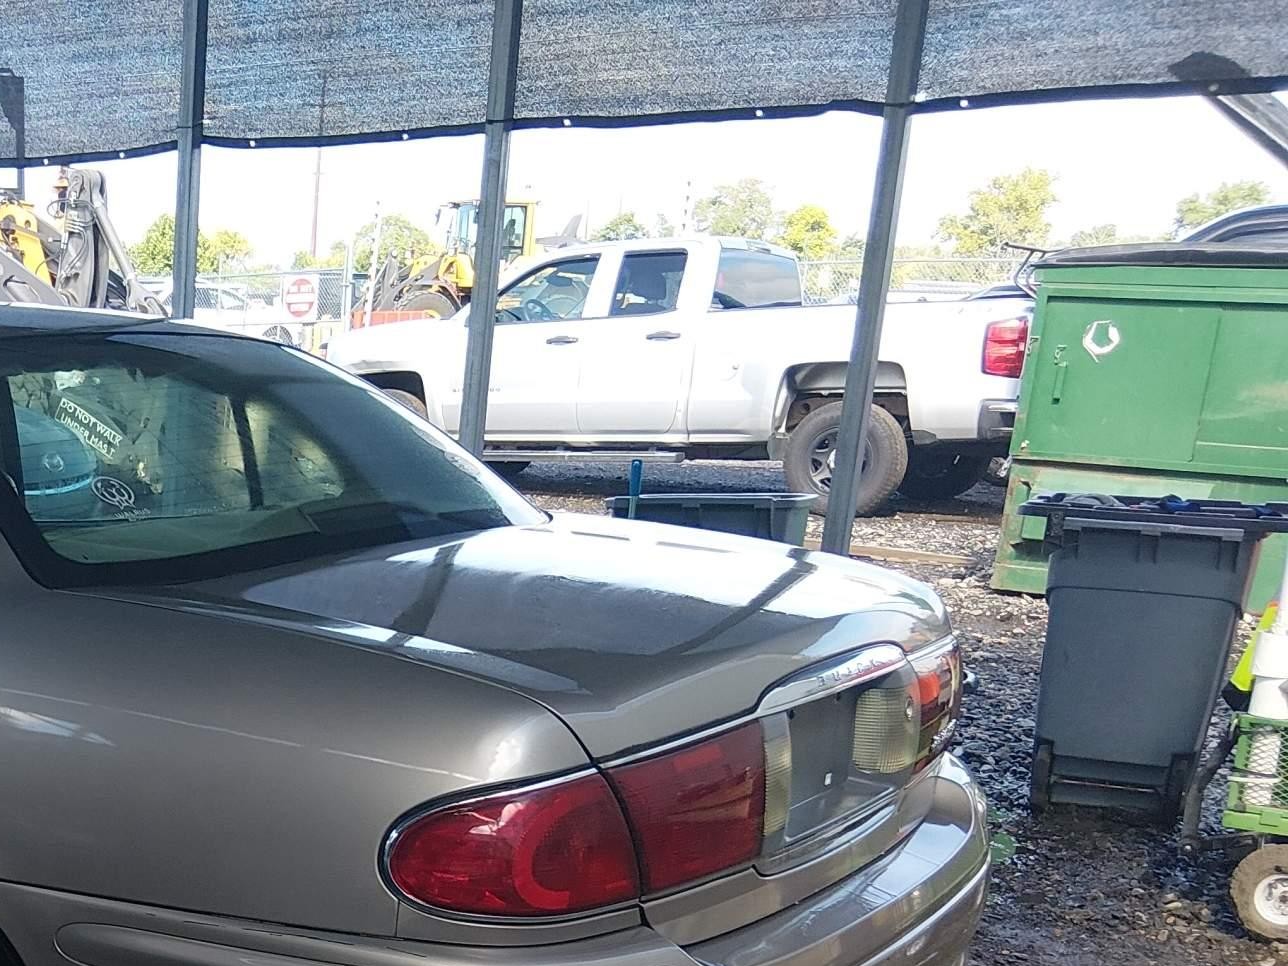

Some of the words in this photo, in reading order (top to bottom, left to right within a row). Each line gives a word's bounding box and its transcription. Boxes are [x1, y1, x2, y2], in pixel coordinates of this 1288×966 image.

[59, 399, 75, 413] DO
[75, 407, 97, 428] NOT
[96, 422, 123, 447] WALK
[60, 412, 90, 438] UNDER
